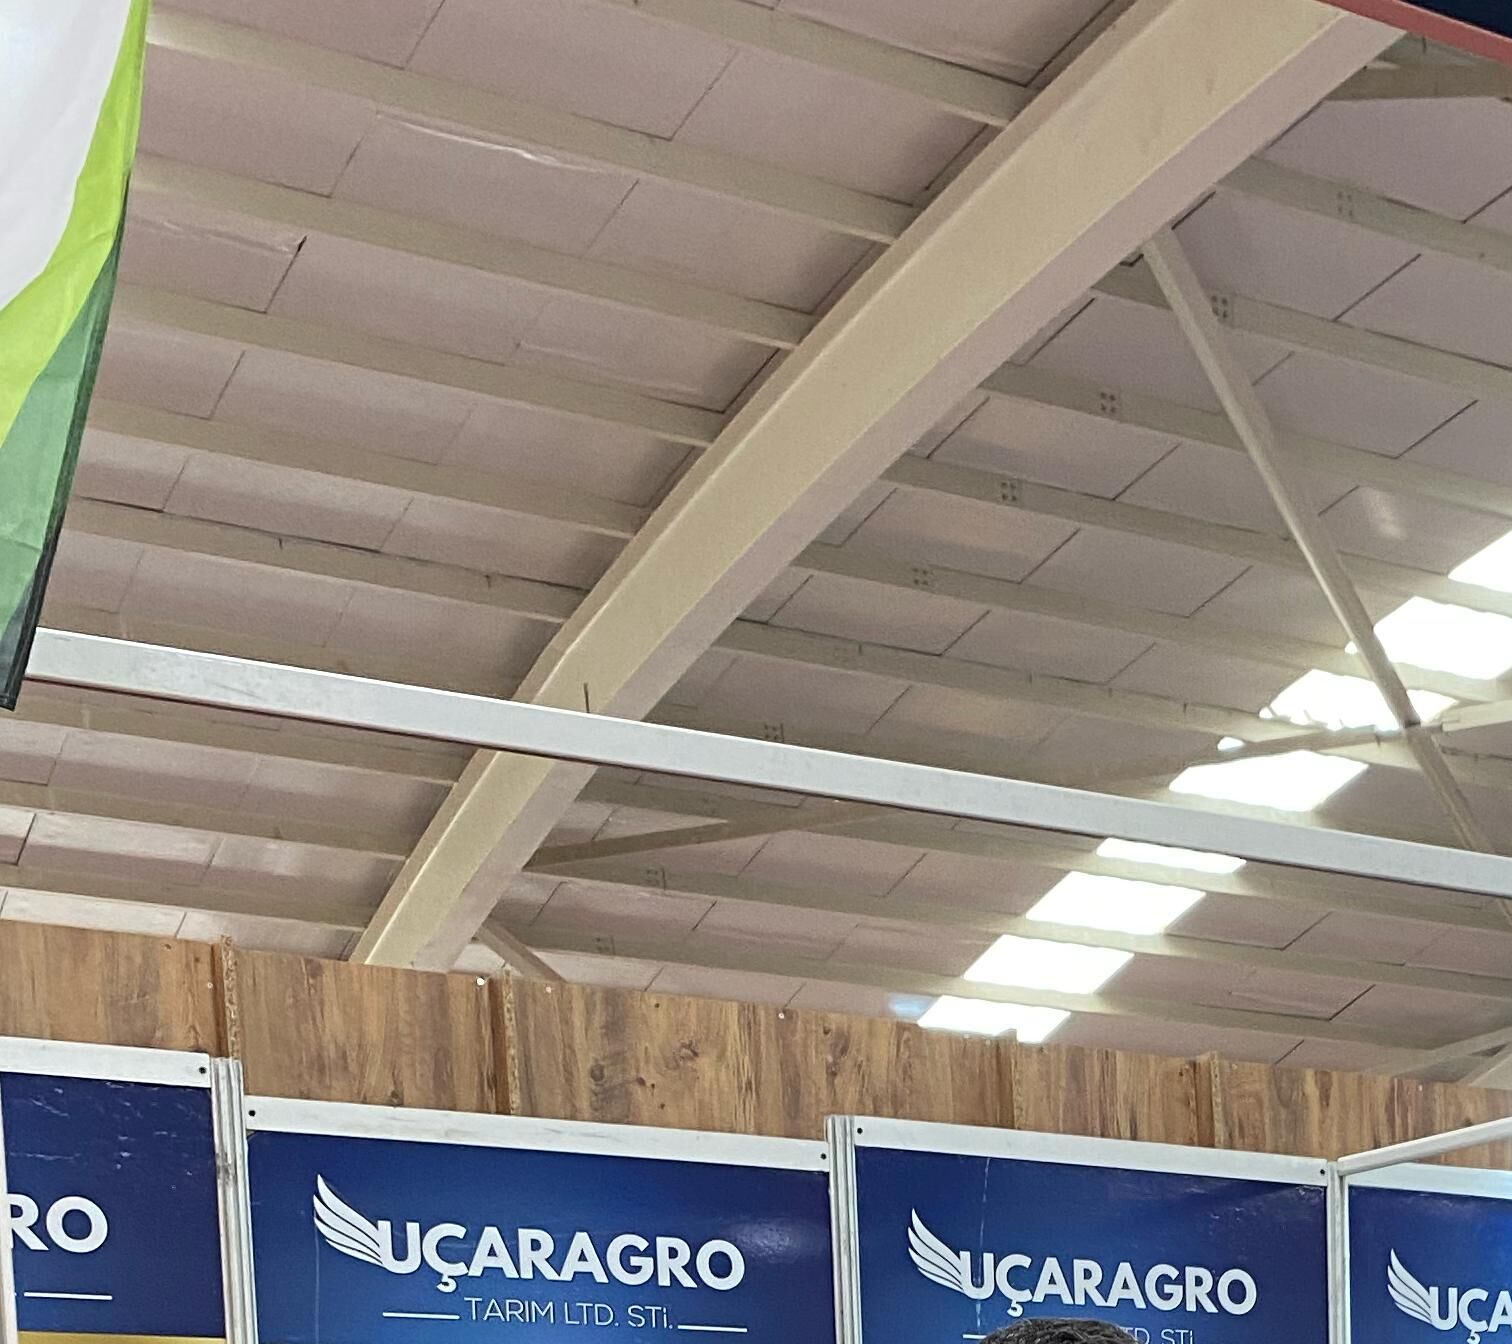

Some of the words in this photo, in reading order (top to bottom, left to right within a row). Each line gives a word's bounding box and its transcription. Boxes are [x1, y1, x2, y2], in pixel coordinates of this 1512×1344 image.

[377, 1220, 746, 1292] UÇARAGRO
[960, 1250, 1258, 1317] UÇARAGRO
[464, 1297, 553, 1324] TARIM
[565, 1303, 619, 1327] LTD.
